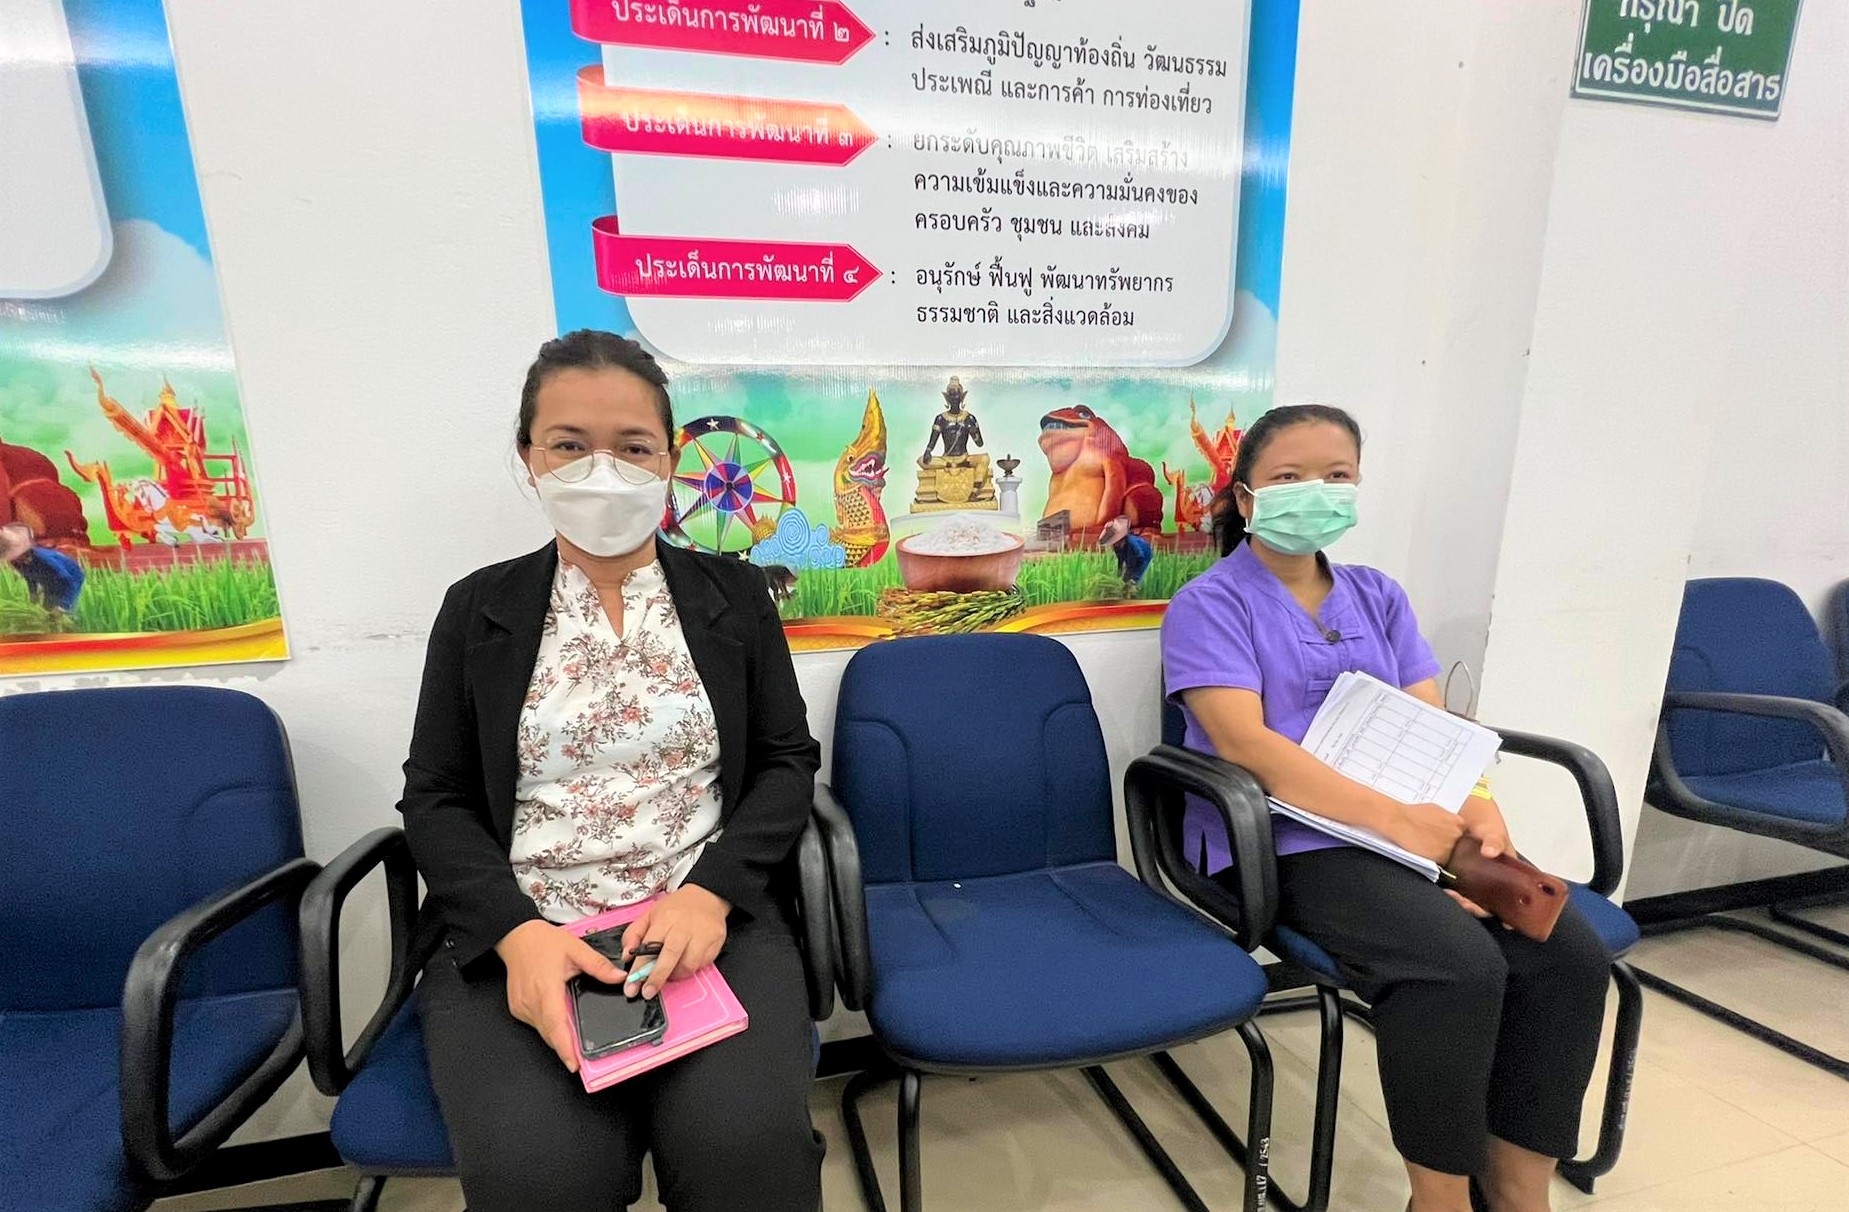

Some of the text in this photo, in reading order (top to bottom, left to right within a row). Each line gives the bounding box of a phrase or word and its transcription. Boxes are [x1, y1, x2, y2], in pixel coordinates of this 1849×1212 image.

[833, 22, 850, 42] ๒
[1717, 0, 1754, 35] ปด
[911, 24, 1136, 68] ส่งเสริมภูมิปัญญาท้องถิ่น
[1144, 45, 1227, 77] วัฒนธรรม
[1583, 32, 1781, 100] เครื่องมือสื่อสาร
[911, 68, 1213, 114] ประเพณี และการค้า การท่องเที่ยว
[913, 128, 1099, 164] ยกระดับคุณภาพชีวิต
[1106, 140, 1189, 168] เสริมสร้าง
[914, 169, 1199, 205] ความเข้มแข็งและความมั่นคงของ
[915, 208, 1150, 242] ครอบครัว ชุมชน และสงคม
[635, 249, 859, 285] ประเด็นการพัฒนาที่ ๔
[916, 261, 981, 294] อนุรักษ์
[989, 256, 1033, 297] ฟื้นฟู
[1040, 266, 1174, 293] พัฒนาทรัพยากร
[916, 297, 1135, 327] ธรรมชาติ และสิ่งแวดล้อม
